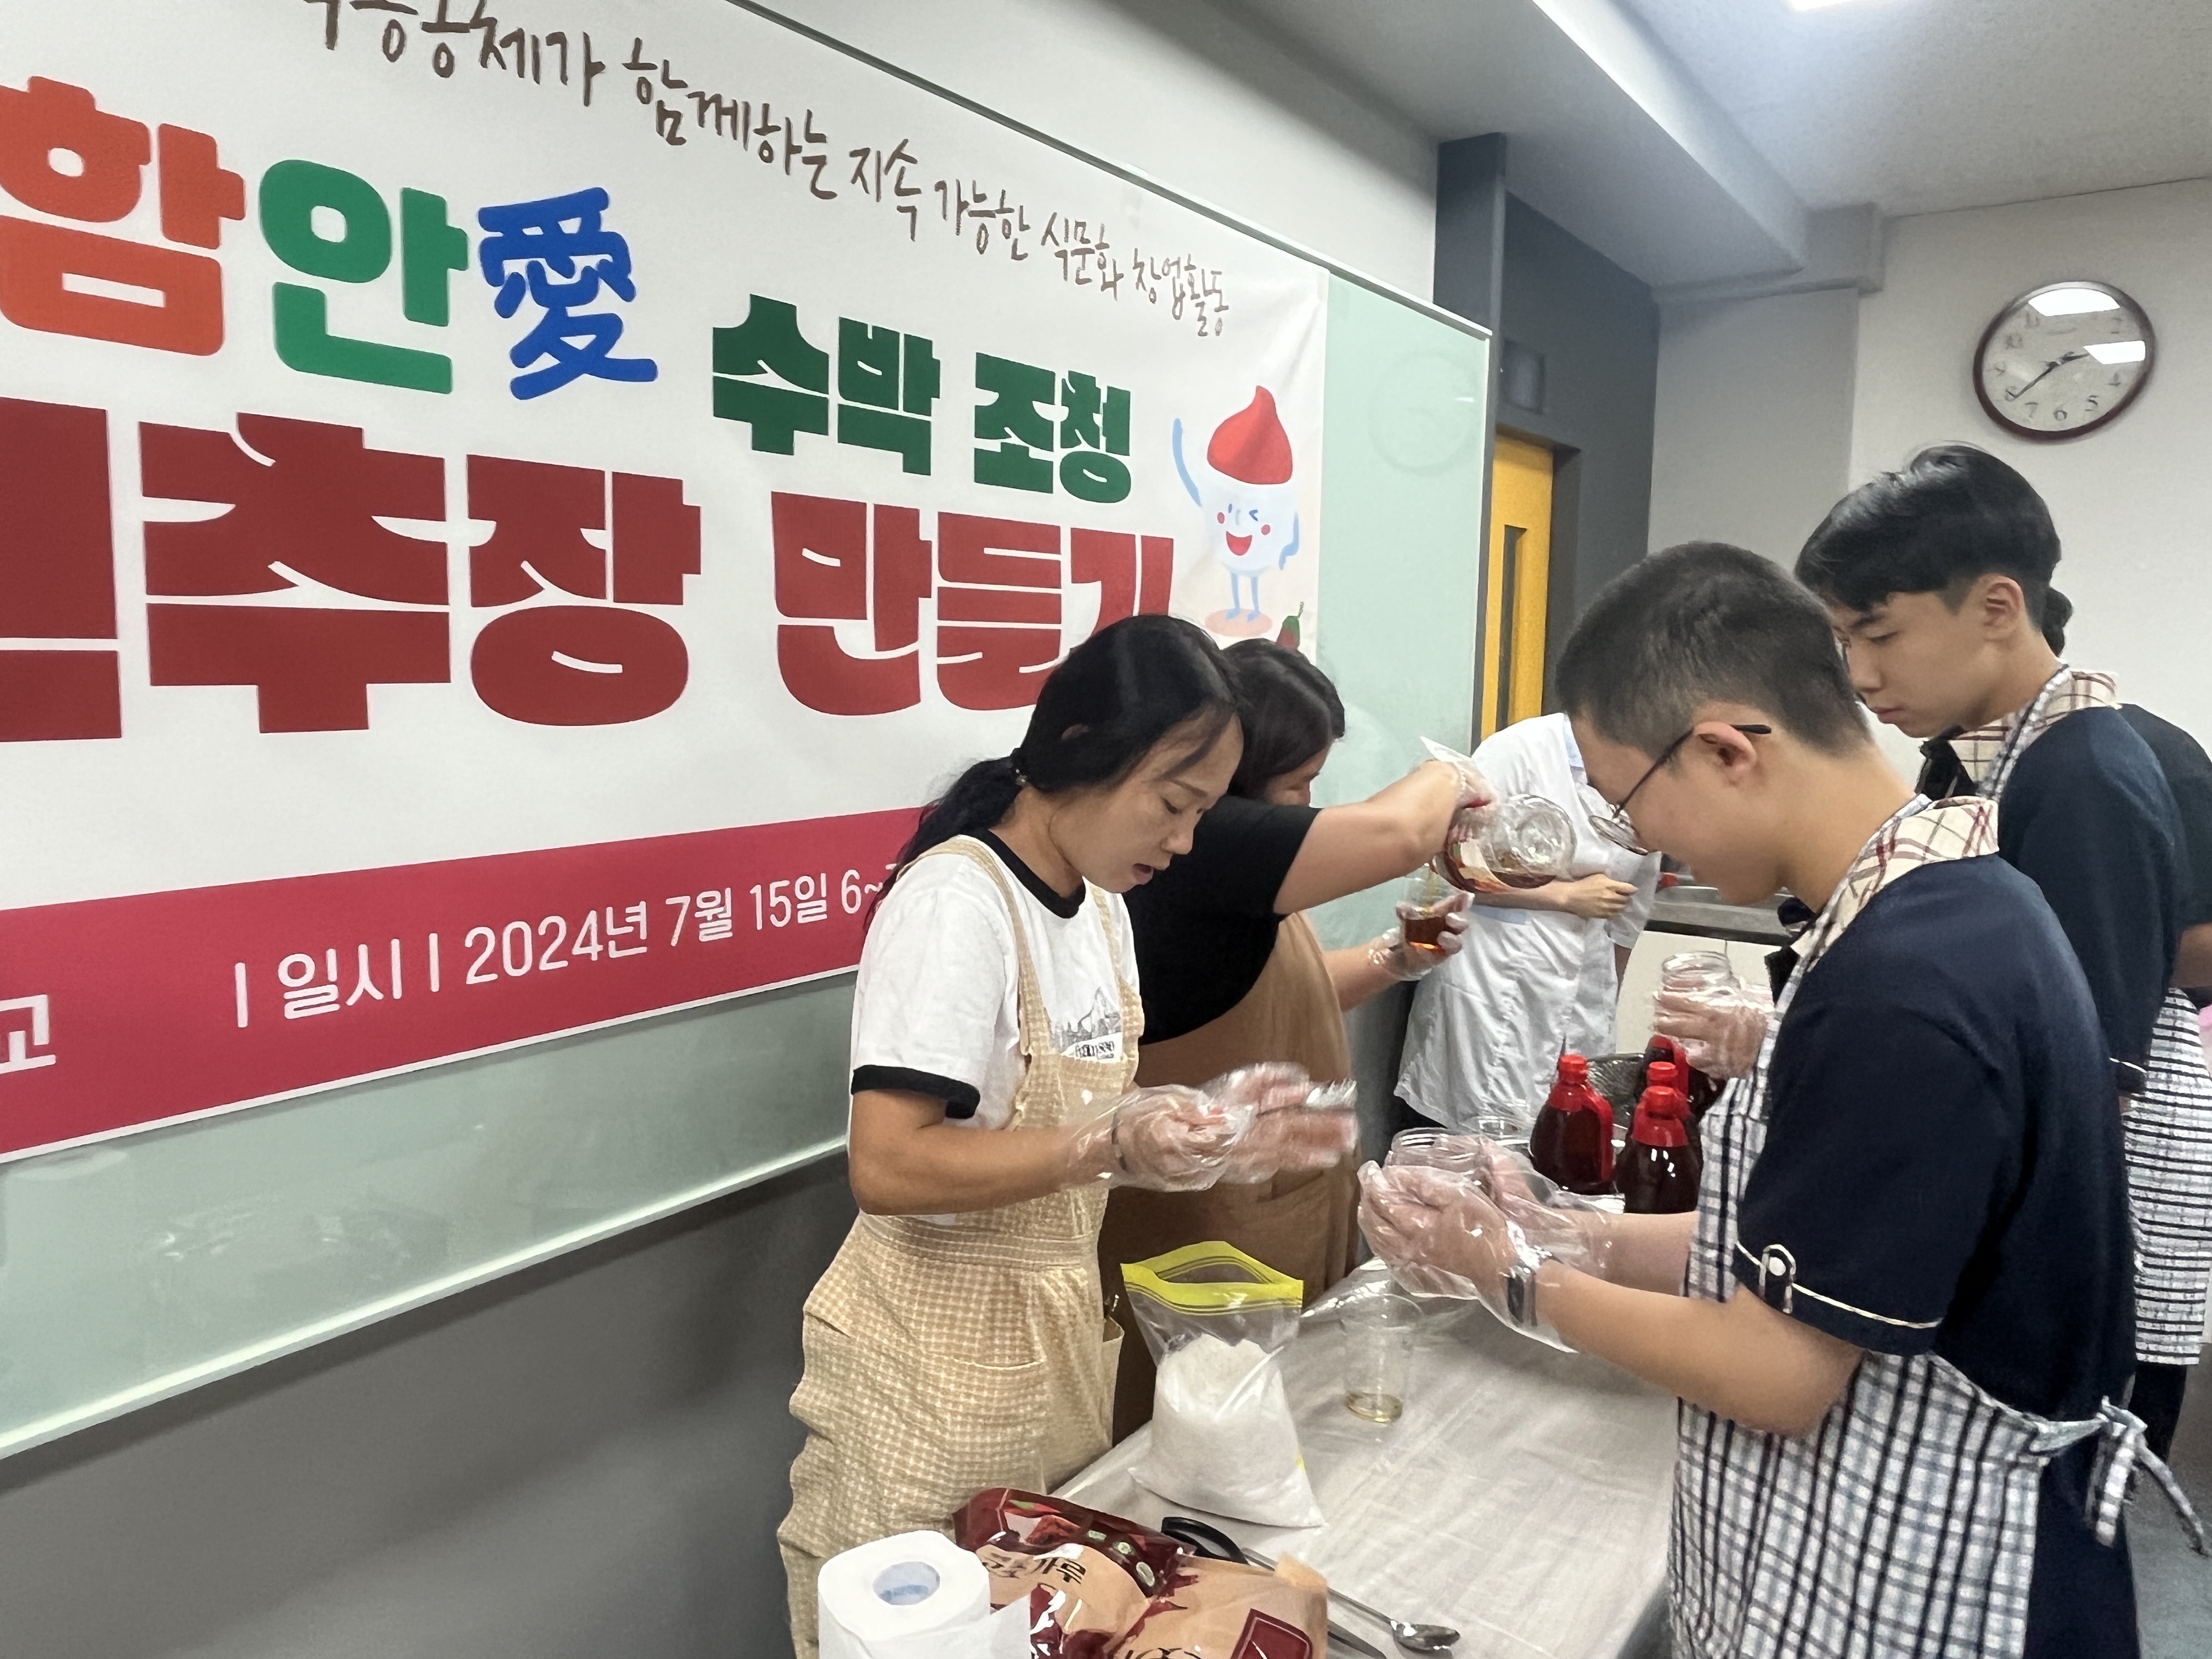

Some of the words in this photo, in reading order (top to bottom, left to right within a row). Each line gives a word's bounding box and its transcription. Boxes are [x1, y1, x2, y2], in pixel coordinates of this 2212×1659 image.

[622, 37, 837, 200] 함께하는
[849, 138, 922, 241] 지속
[934, 179, 1031, 261] 가능한
[1041, 212, 1124, 301] 식문화
[712, 294, 940, 476] 수박
[974, 352, 1132, 503] 조청
[278, 939, 402, 1019] 일시
[464, 900, 647, 985] 2024년
[665, 887, 733, 946] 7월
[749, 873, 828, 930] 15일
